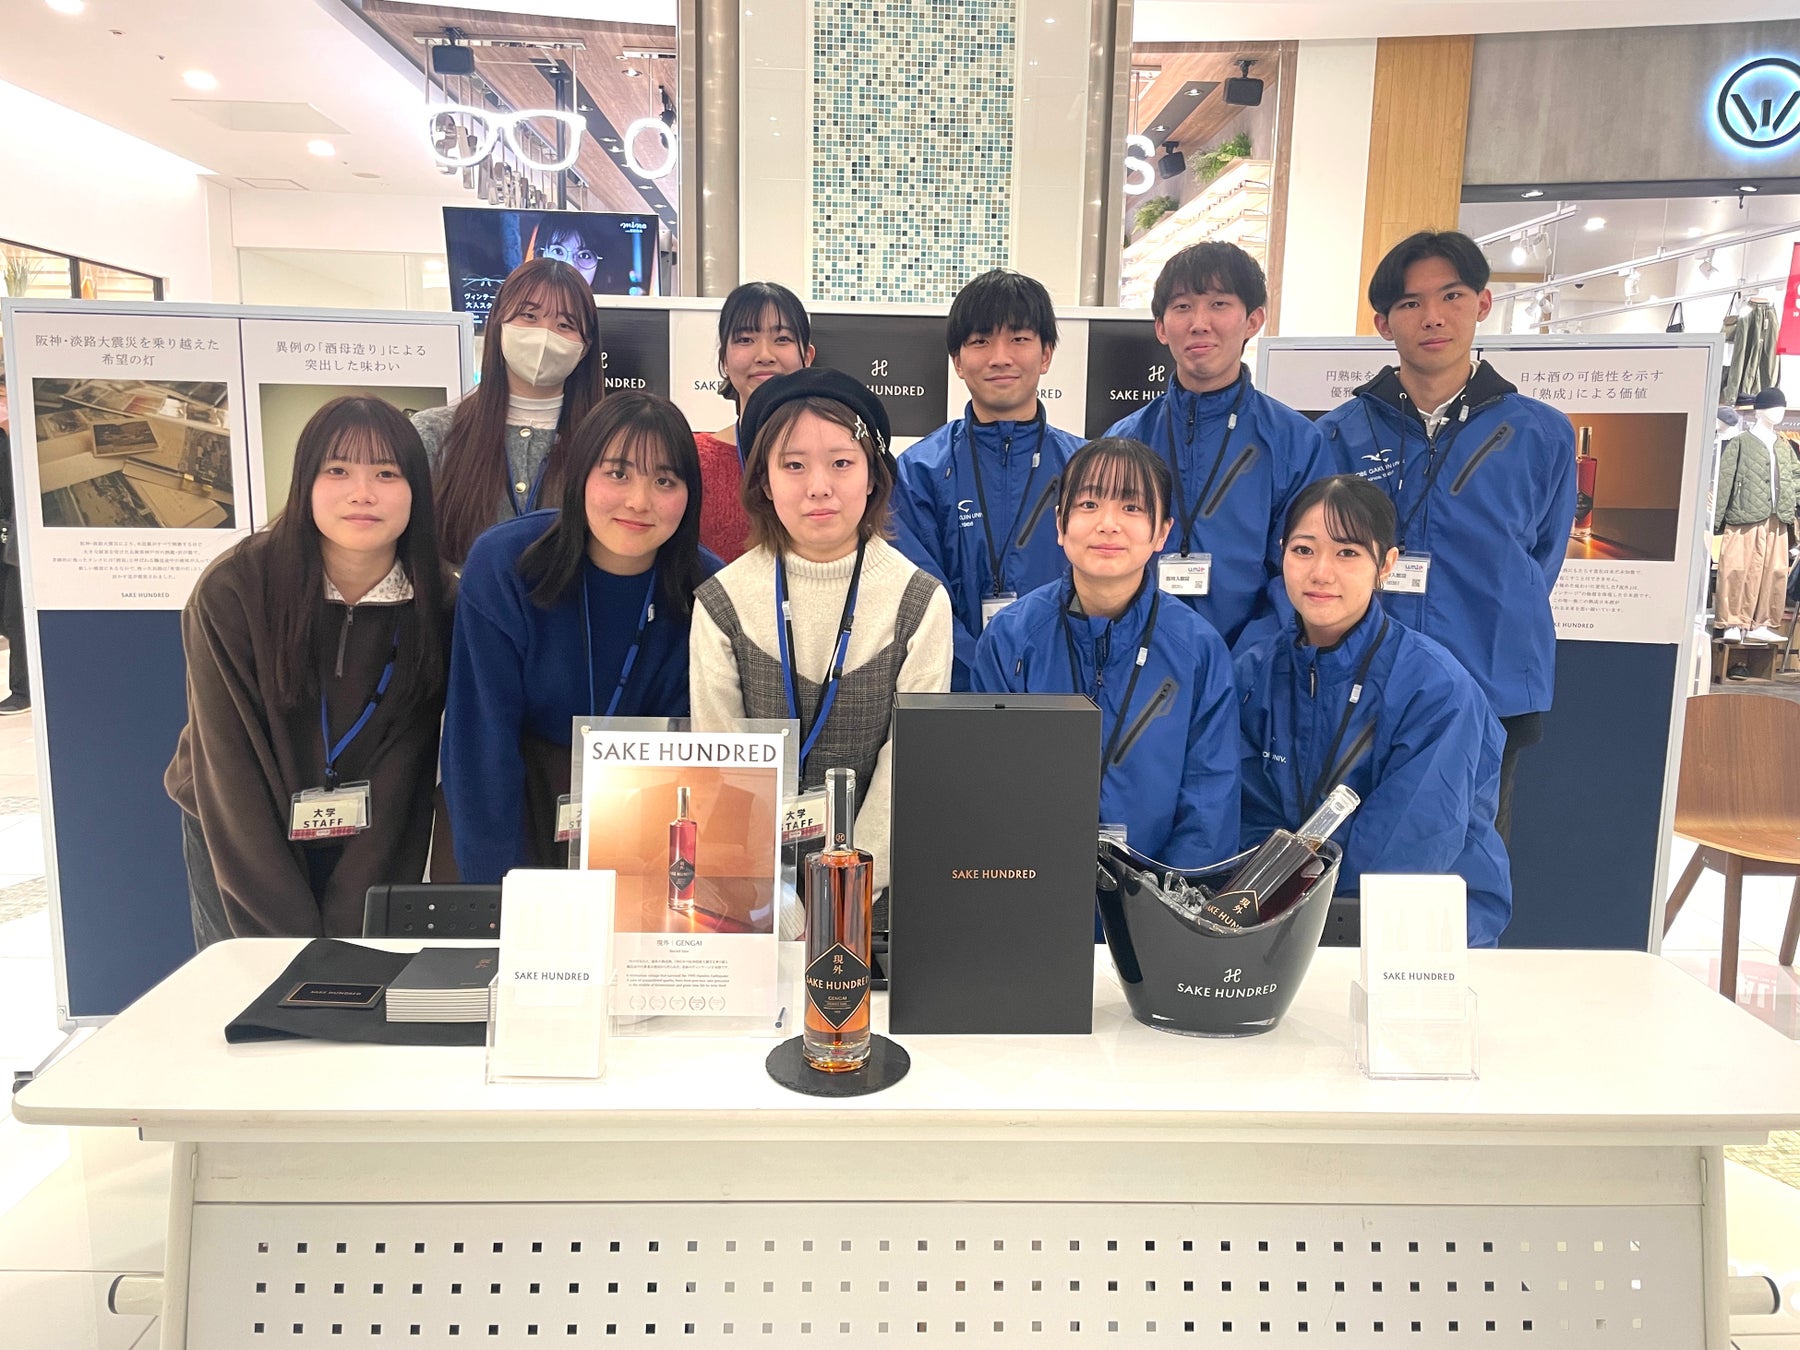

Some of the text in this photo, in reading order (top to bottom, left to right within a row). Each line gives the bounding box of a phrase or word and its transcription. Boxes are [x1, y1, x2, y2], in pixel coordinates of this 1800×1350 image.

[35, 334, 220, 350] 阪神・淡路大震災を乗り越えた
[276, 341, 427, 357] 異例の「酒母造り」による
[102, 353, 155, 367] 希望の灯
[304, 358, 401, 372] 突出した味わい
[605, 377, 647, 389] NDRED
[1520, 370, 1664, 383] 日本酒の可能性を示す
[1110, 389, 1139, 401] SAKE
[1531, 387, 1649, 400] 「熟成」による価値
[592, 741, 777, 763] SAKE HUNDRED
[313, 807, 336, 818] 大学
[786, 808, 806, 821] 大学
[303, 818, 344, 829] STAFF
[781, 818, 814, 831] TAFF
[952, 869, 1037, 879] SAKE HUNDRED
[675, 939, 703, 947] GENGAI
[832, 954, 844, 975] 現外
[514, 970, 590, 981] SAKE HUNDRED
[1383, 971, 1455, 981] SAKE HUNDRED
[1177, 982, 1278, 999] SAKE HUNDRED
